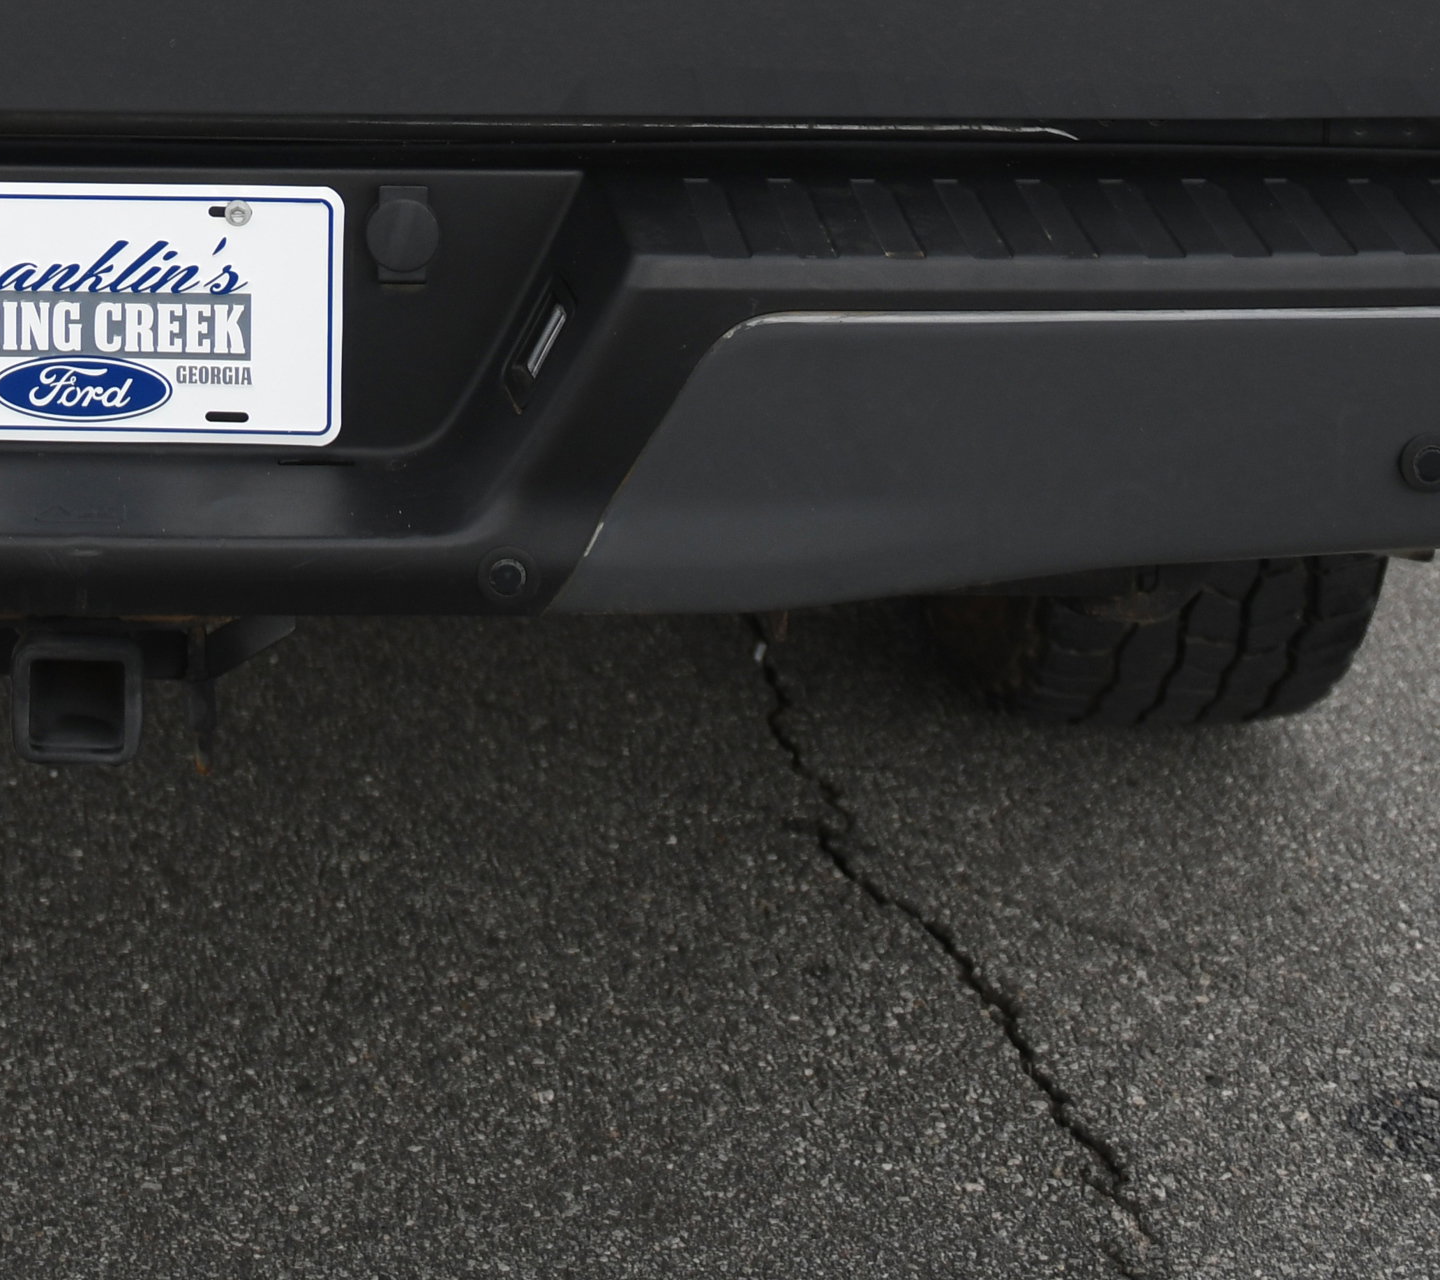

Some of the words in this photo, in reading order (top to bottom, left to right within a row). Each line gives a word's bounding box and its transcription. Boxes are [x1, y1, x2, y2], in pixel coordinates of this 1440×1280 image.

[94, 301, 246, 355] CREEK
[28, 365, 131, 409] Ford
[176, 365, 252, 386] GEORGIA
